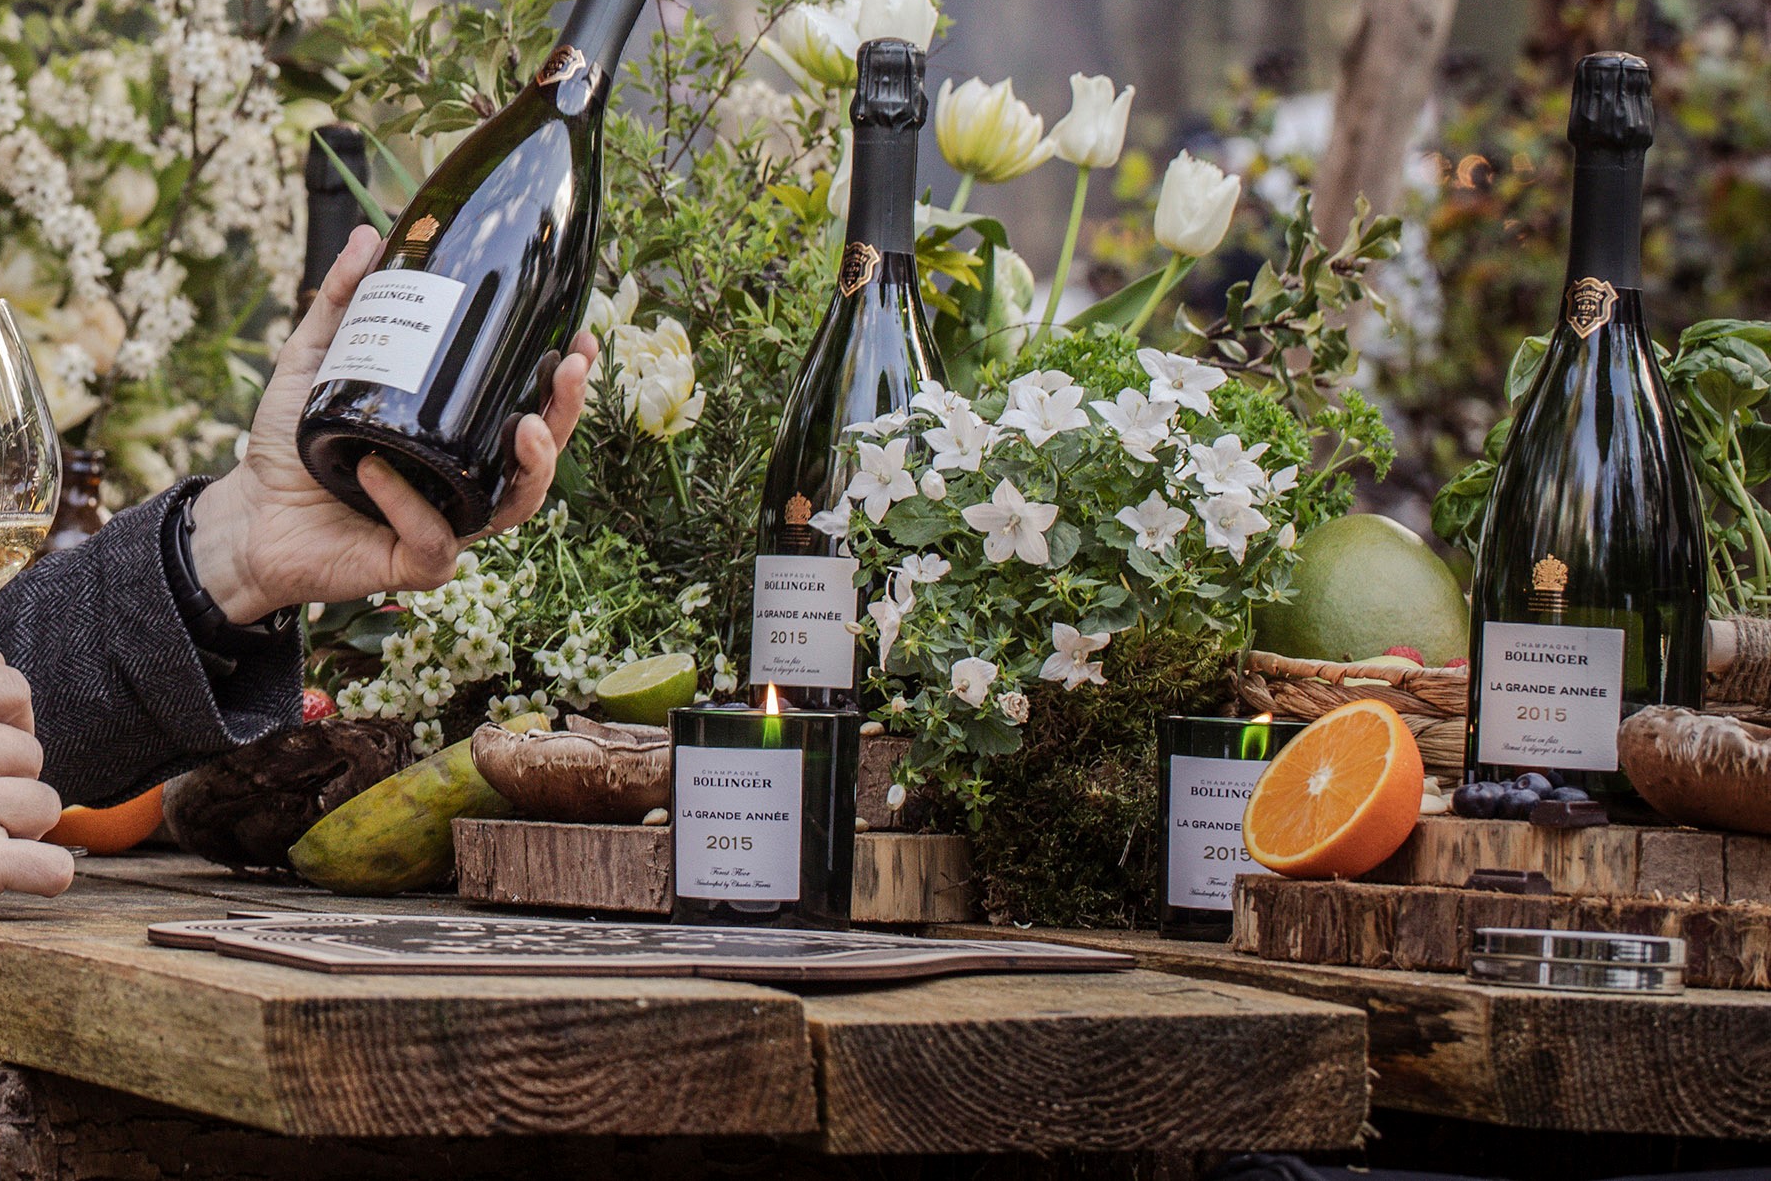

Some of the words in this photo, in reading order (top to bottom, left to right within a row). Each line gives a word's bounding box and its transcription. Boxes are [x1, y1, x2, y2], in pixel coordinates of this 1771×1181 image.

[360, 291, 425, 304] BOLLINGER
[351, 315, 389, 326] GRANDE
[348, 333, 391, 346] 2015
[764, 580, 825, 592] BOLLINGER
[764, 610, 799, 619] GRANDE
[802, 611, 842, 621] ANNÉE
[770, 630, 808, 645] 2015
[1515, 641, 1577, 651] CHAMPAGNE
[1504, 651, 1588, 665] BOLLINGER
[1490, 682, 1502, 691] LA
[1506, 683, 1556, 695] GRANDE
[1559, 685, 1607, 698] ANNÉE
[1516, 706, 1567, 722] 2015
[702, 769, 760, 777] CHAMPAGNE
[693, 776, 772, 789] BOLLINGER
[1200, 779, 1255, 788] CHAMPAGN
[1190, 786, 1252, 800] BOLLING
[682, 809, 693, 818] LA
[695, 810, 741, 820] GRANDE
[745, 811, 790, 821] ANNÉE
[1177, 819, 1189, 828] LA
[1192, 820, 1242, 832] GRANDE
[706, 835, 753, 851] 2015
[1203, 845, 1252, 862] 2015
